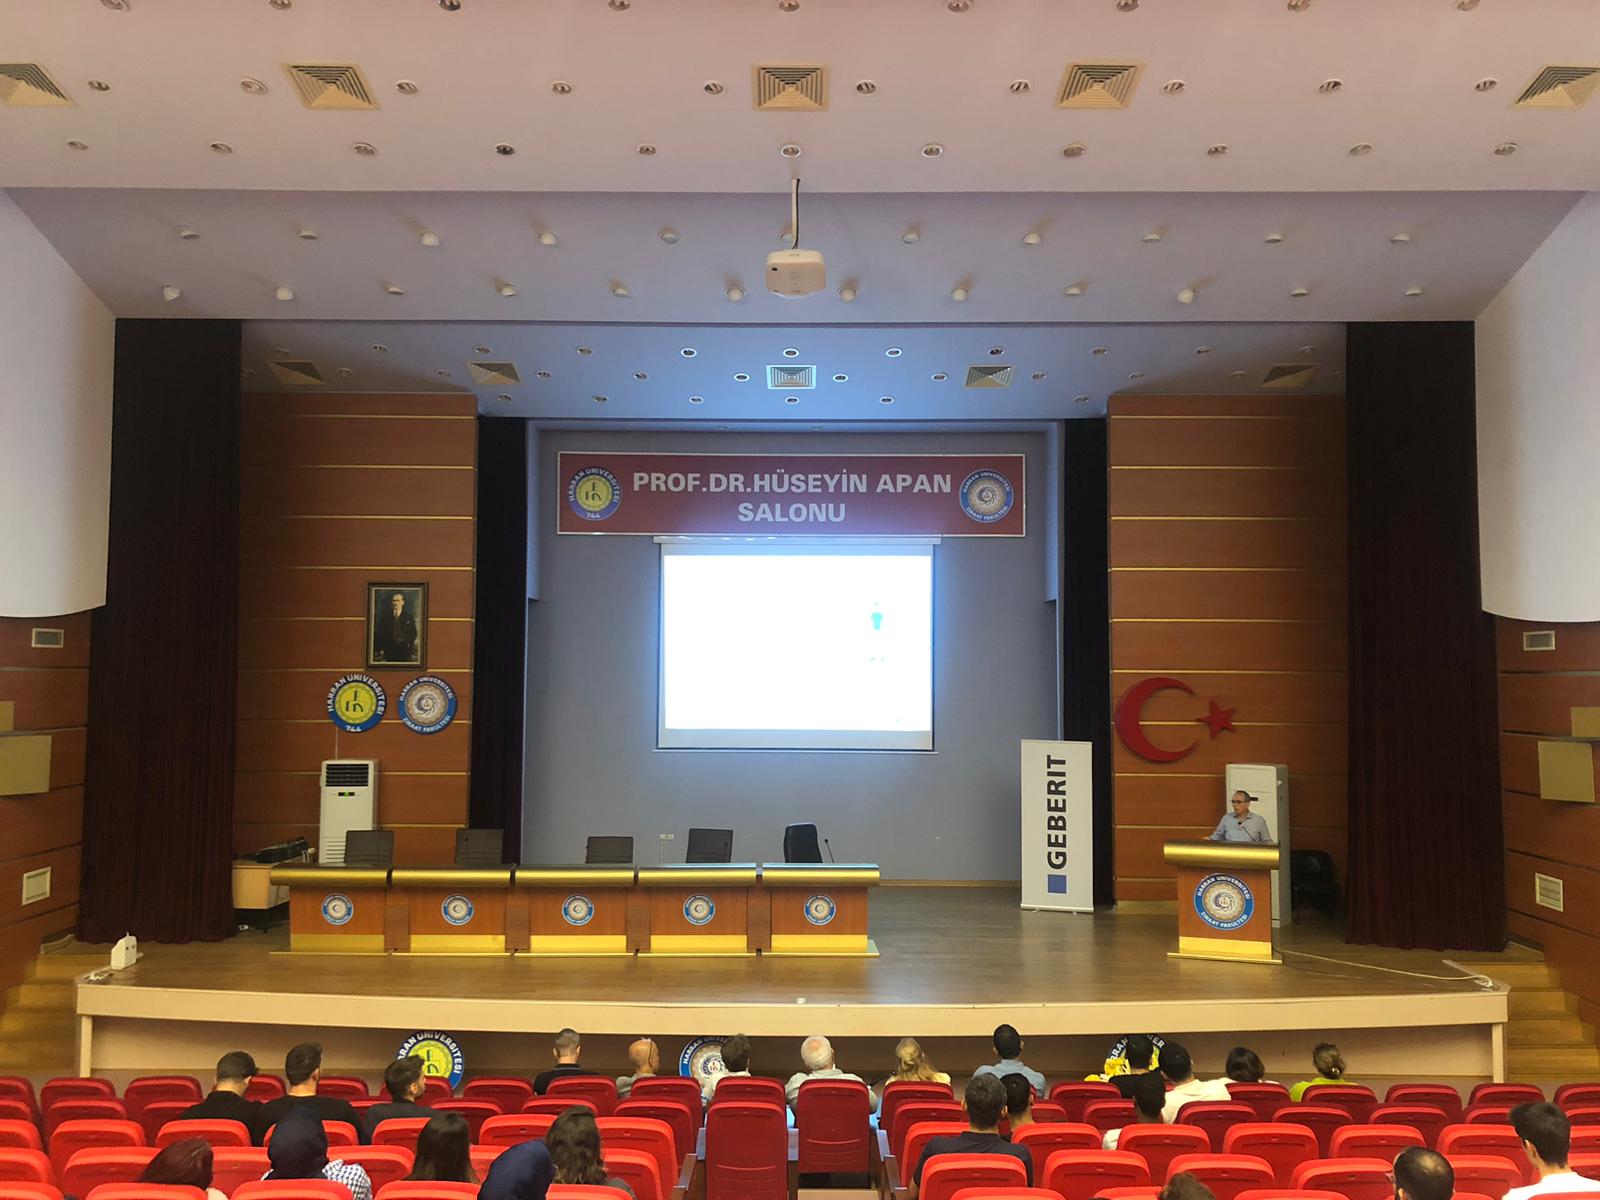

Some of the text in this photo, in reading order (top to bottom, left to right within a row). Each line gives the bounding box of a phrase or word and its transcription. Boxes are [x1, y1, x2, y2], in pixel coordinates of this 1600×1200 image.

[633, 468, 952, 493] PROF.DR.HÜSEYİN APAN
[737, 502, 846, 522] SALONU
[327, 676, 347, 713] HARRAN
[1046, 754, 1067, 870] GEBERIT
[1197, 876, 1216, 897] HARRAN
